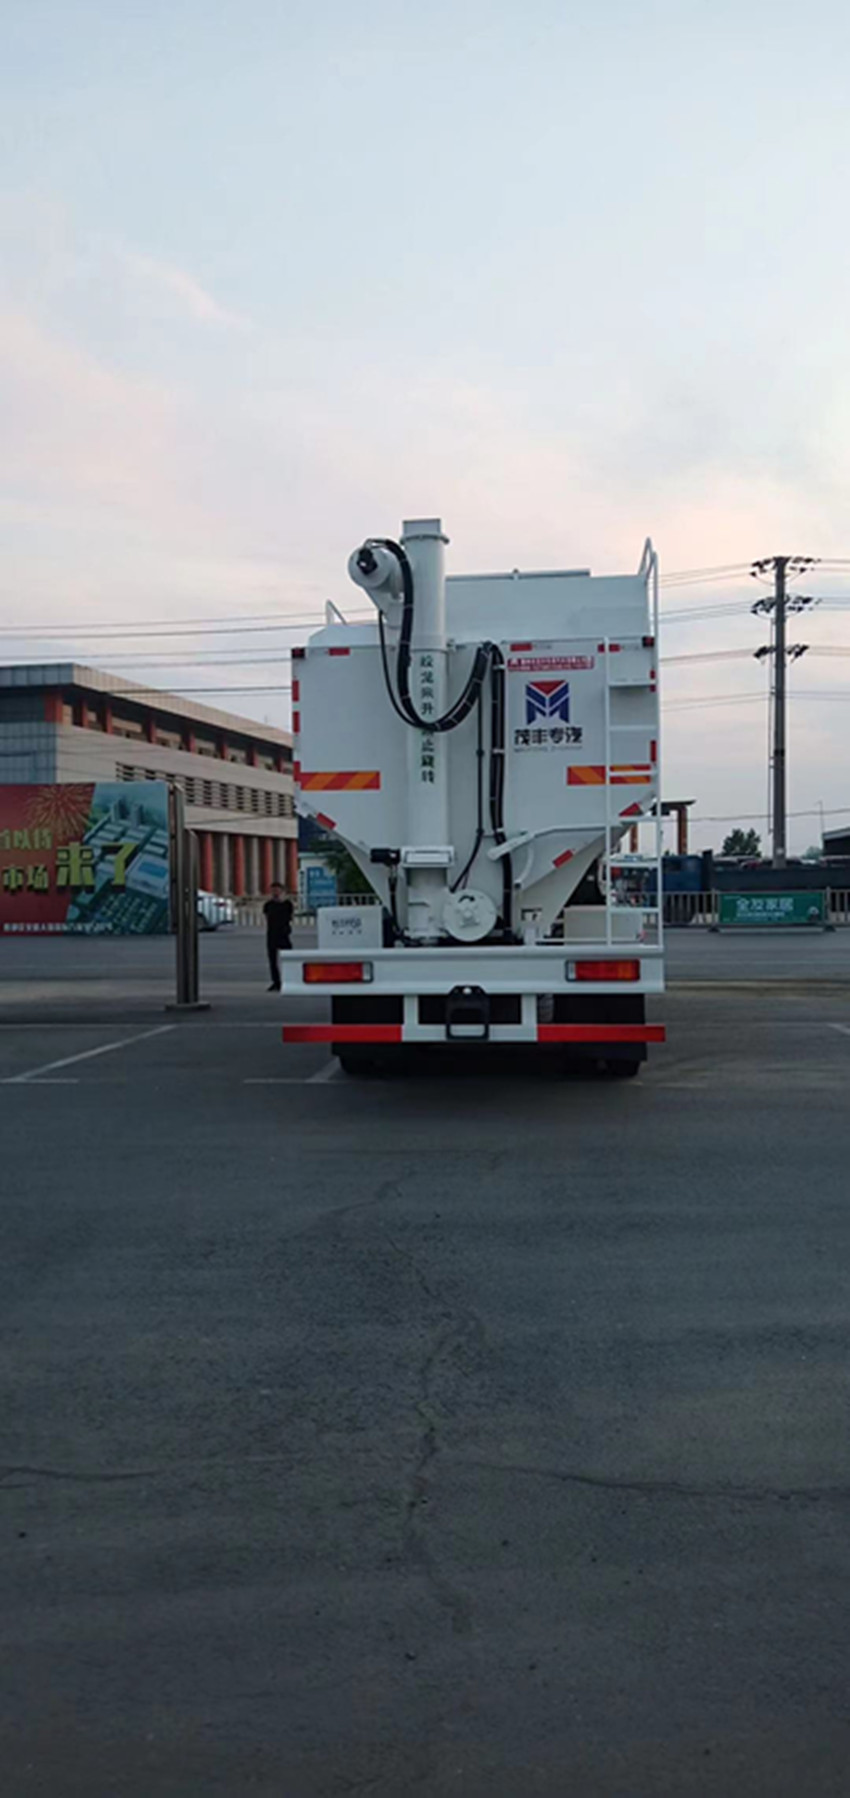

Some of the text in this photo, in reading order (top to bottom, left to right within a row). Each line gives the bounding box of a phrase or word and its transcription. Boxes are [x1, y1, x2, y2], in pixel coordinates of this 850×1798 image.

[513, 726, 583, 745] 茂丰专汽
[3, 841, 138, 891] 市场 来了
